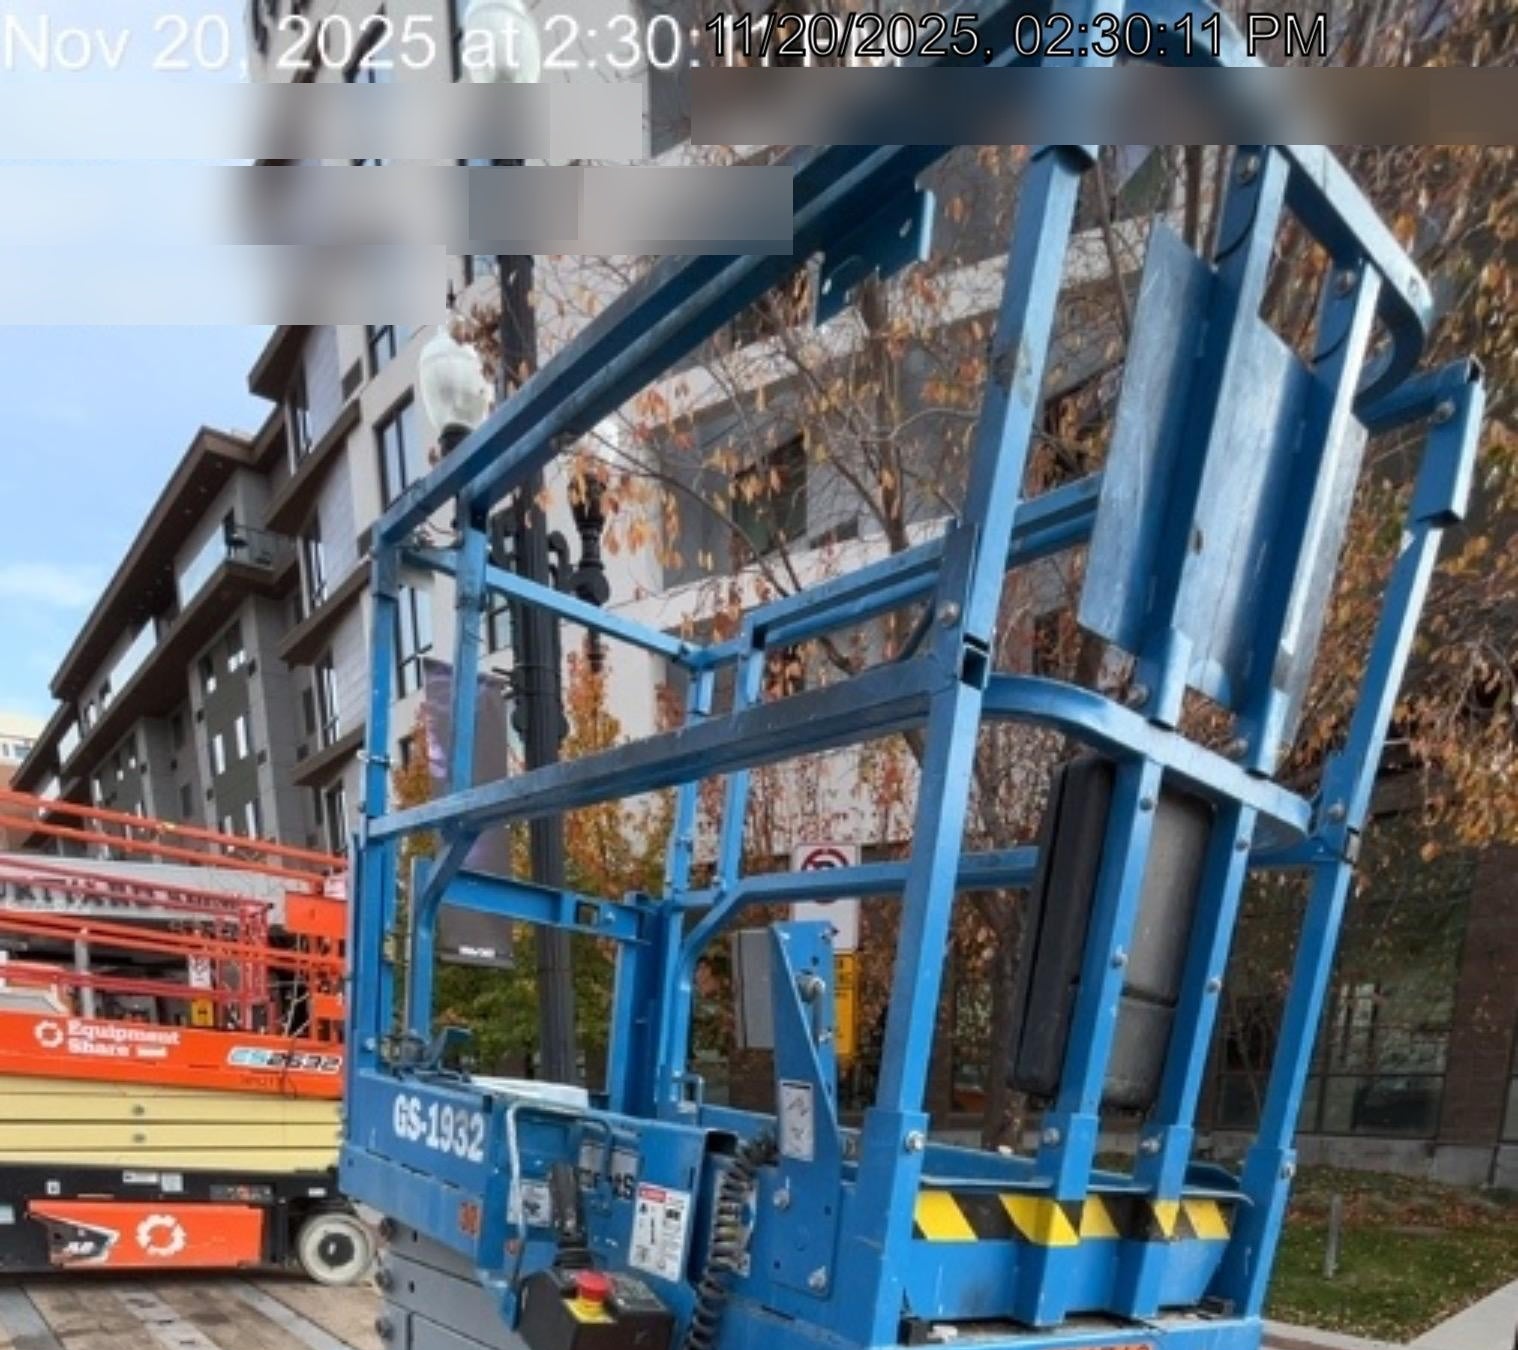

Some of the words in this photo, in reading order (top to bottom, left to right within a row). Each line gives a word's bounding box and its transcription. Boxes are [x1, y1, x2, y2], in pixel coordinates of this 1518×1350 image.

[67, 1019, 180, 1045] Equipment
[68, 1038, 130, 1057] Share
[393, 1093, 484, 1163] GS-1932
